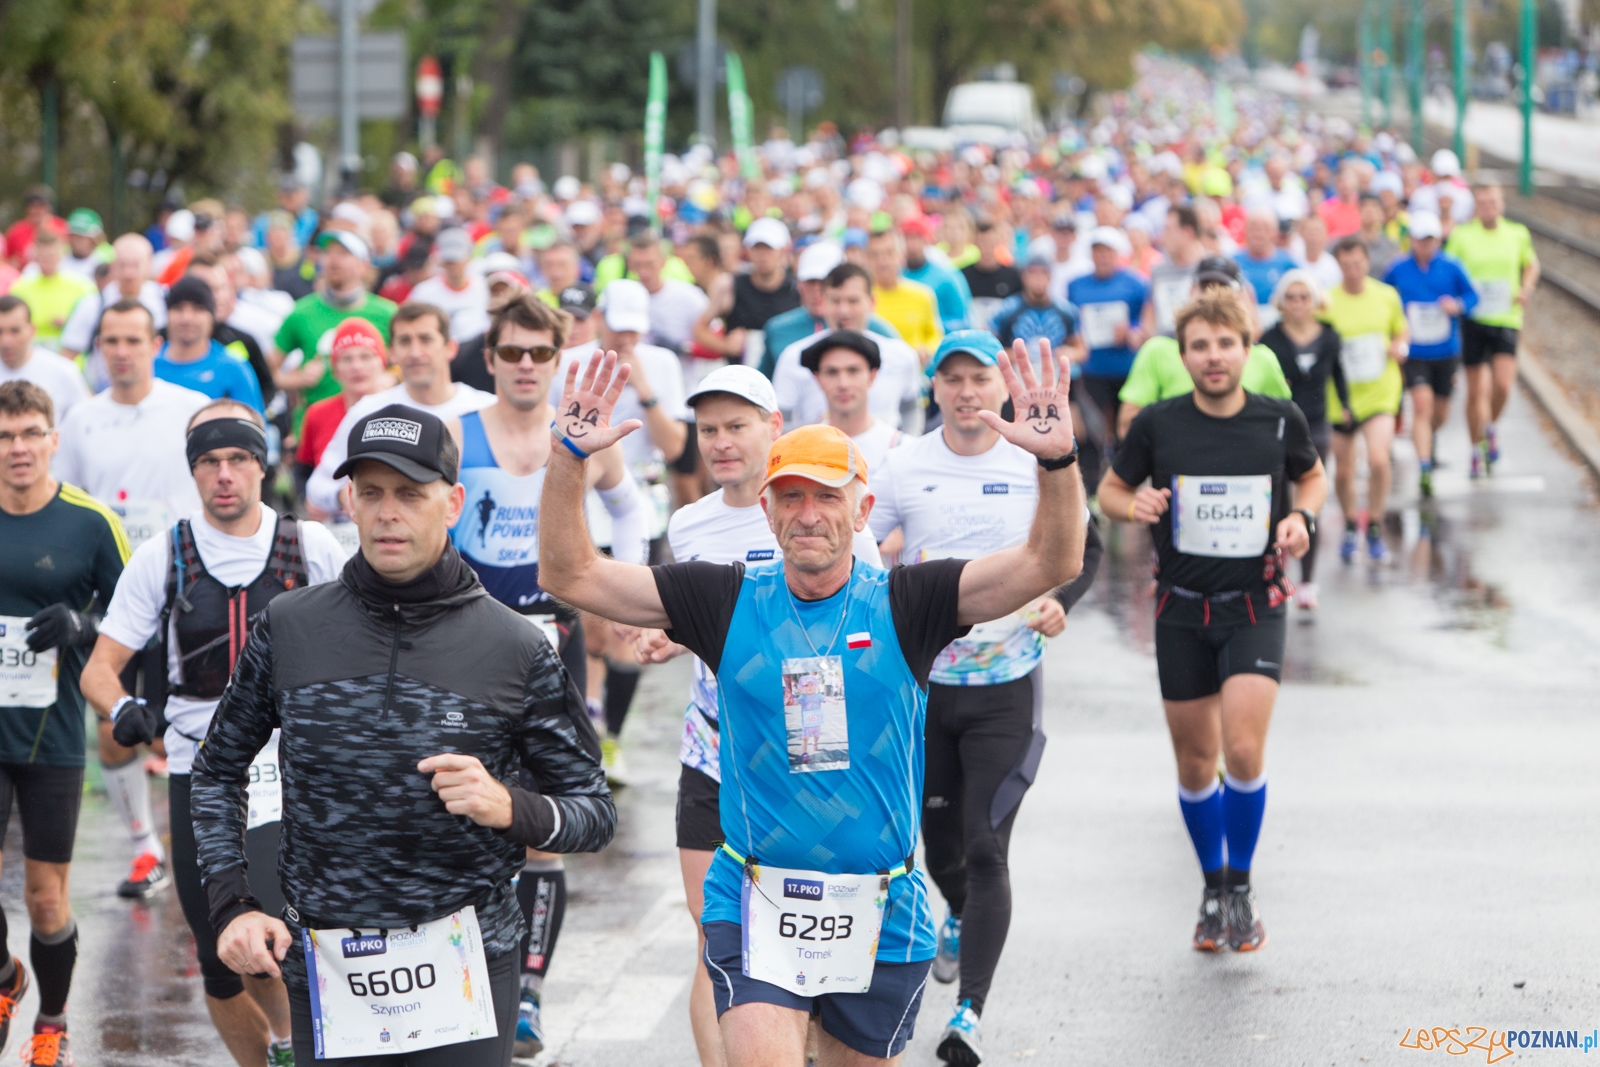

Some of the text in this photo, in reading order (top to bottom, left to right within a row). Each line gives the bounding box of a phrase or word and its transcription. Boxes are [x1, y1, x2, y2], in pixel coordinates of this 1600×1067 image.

[367, 421, 419, 432] BYDGOSZCZ
[365, 428, 417, 440] TRIATHLON
[1196, 504, 1254, 520] 6644
[827, 891, 857, 899] maraton
[778, 912, 854, 941] 6293
[390, 937, 427, 949] maraton
[796, 947, 832, 960] Tomek
[347, 963, 436, 997] 6600
[370, 1001, 422, 1017] Szymon
